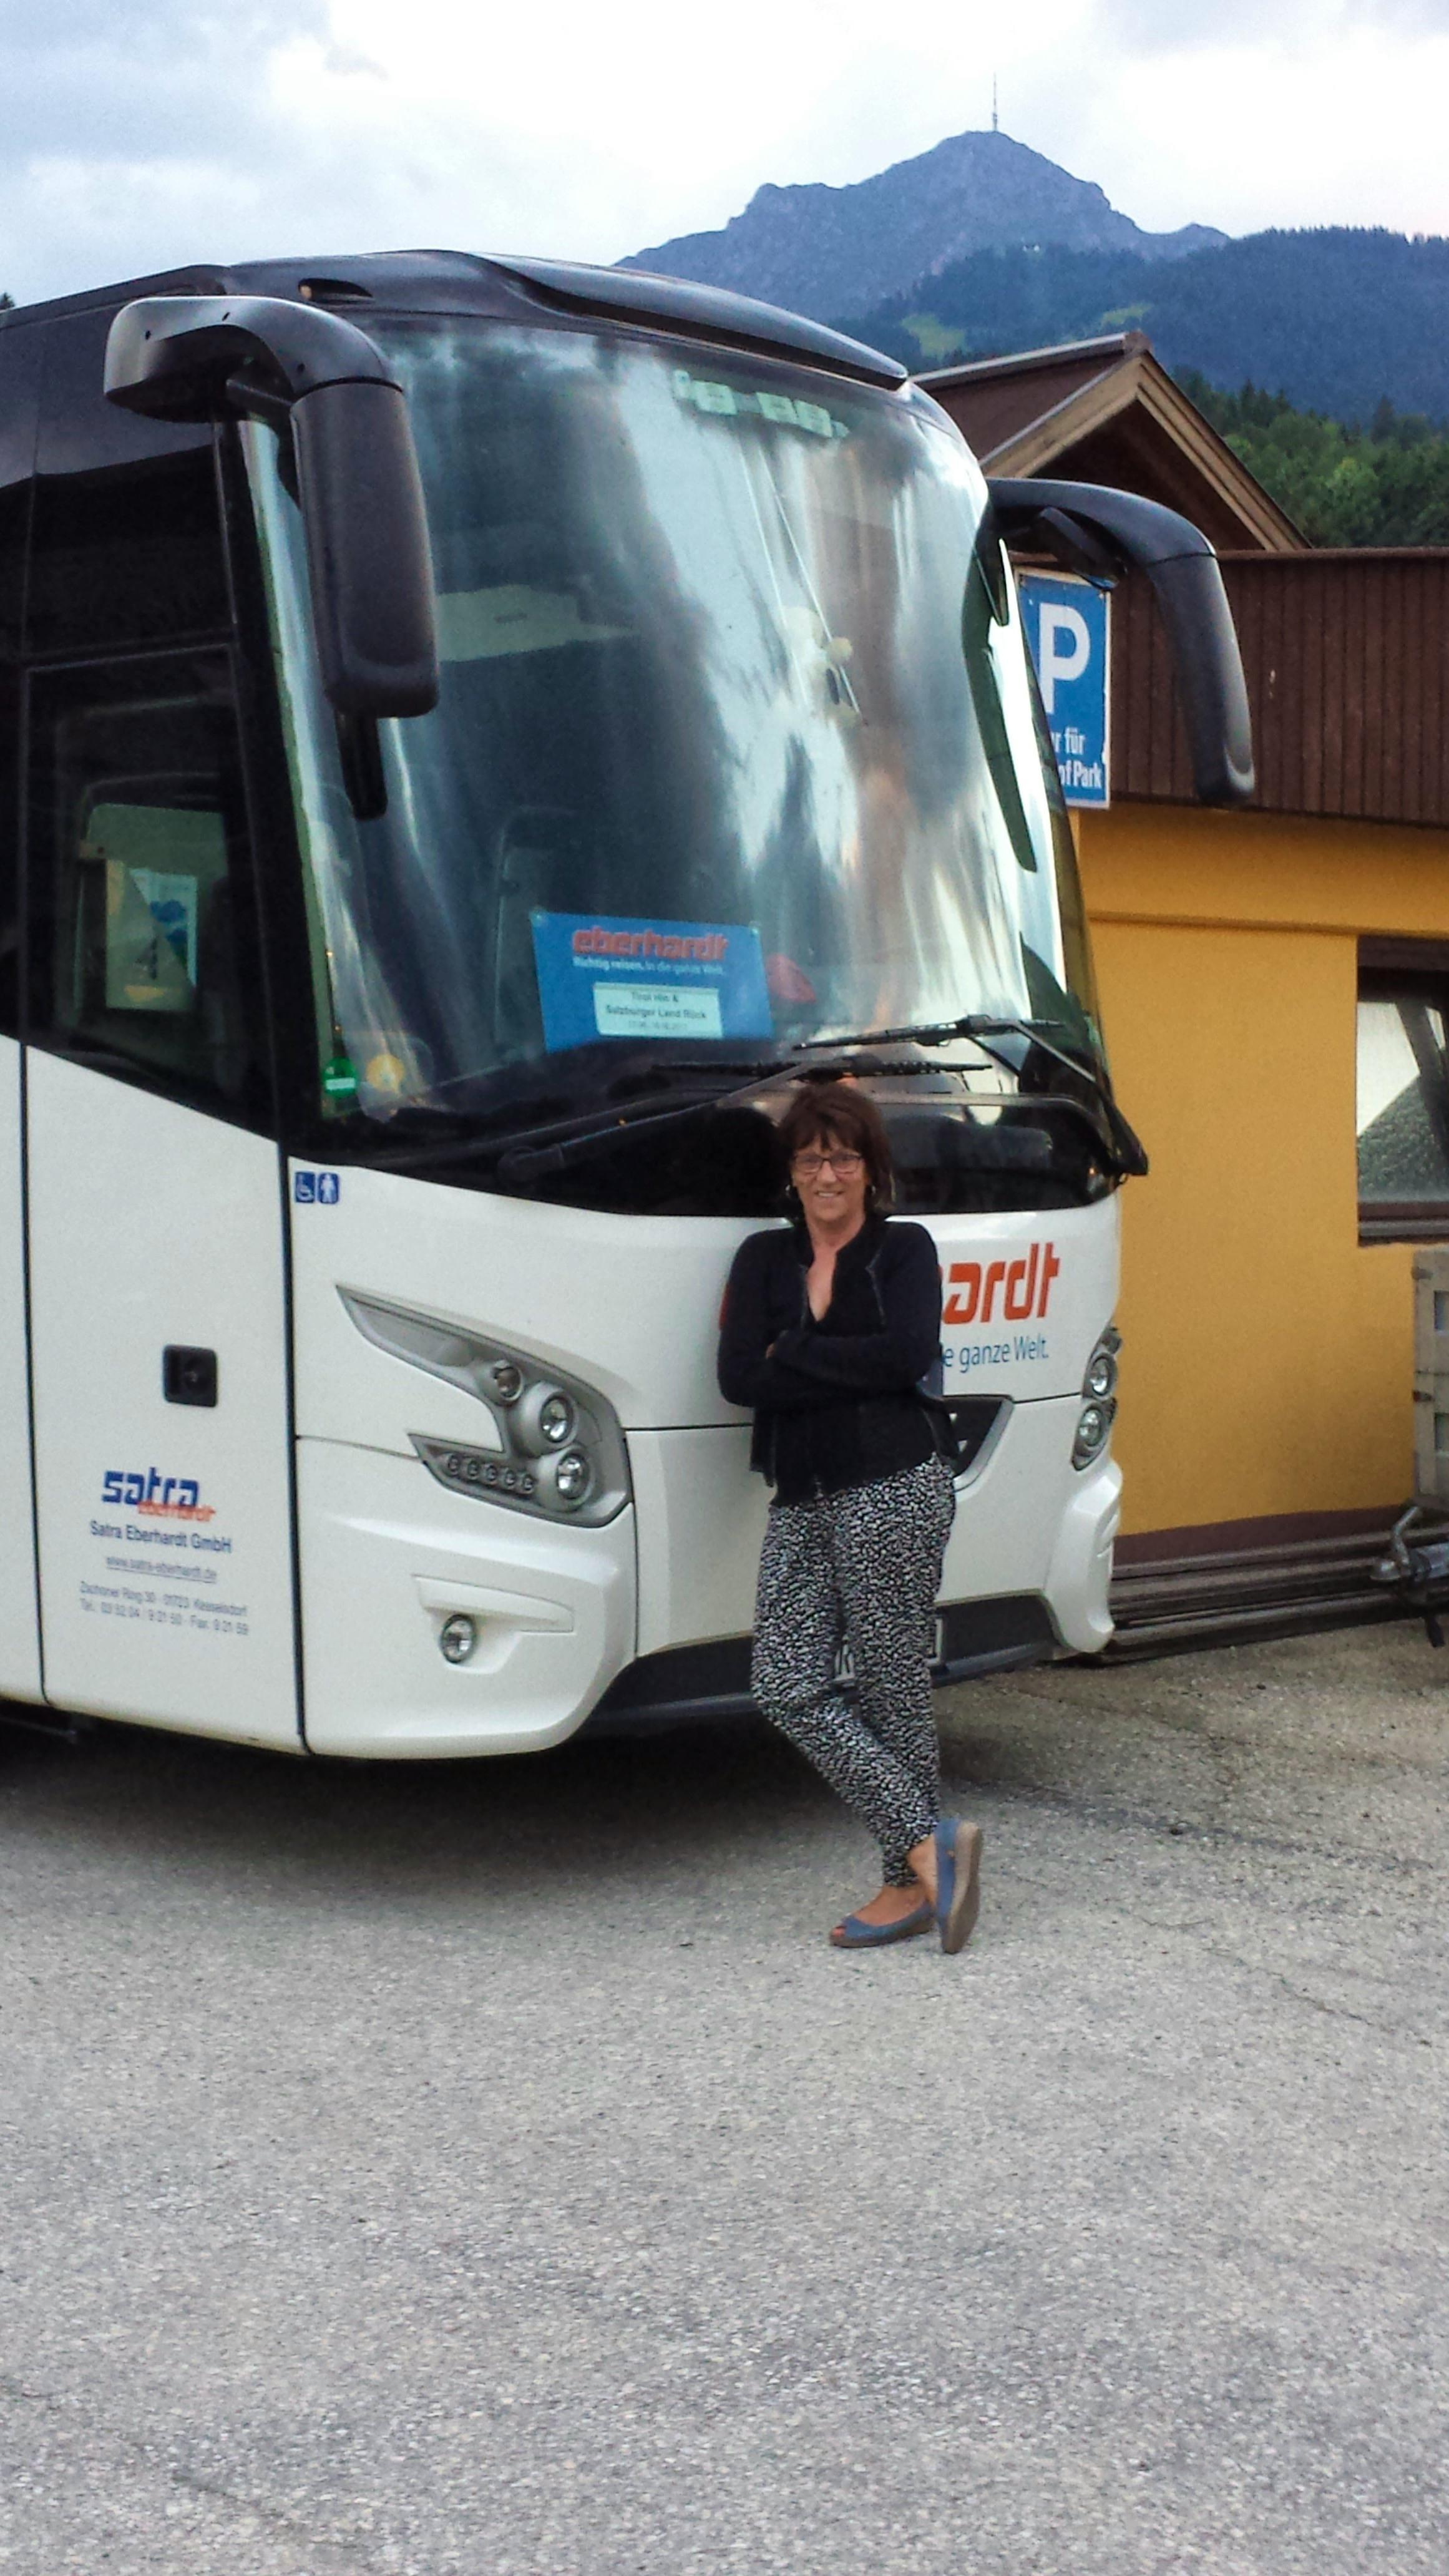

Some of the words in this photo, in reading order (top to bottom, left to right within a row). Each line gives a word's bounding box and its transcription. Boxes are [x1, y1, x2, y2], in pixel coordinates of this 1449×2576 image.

[1038, 603, 1091, 715] P
[1064, 727, 1086, 754] für
[1073, 759, 1102, 789] Park
[572, 925, 728, 960] eberhardt
[940, 1242, 1060, 1324] ardt
[959, 1342, 1010, 1373] ganze
[101, 1466, 199, 1507] satra
[90, 1520, 122, 1539] Satra
[126, 1525, 187, 1548] Eberhardt
[190, 1532, 232, 1553] GmbH
